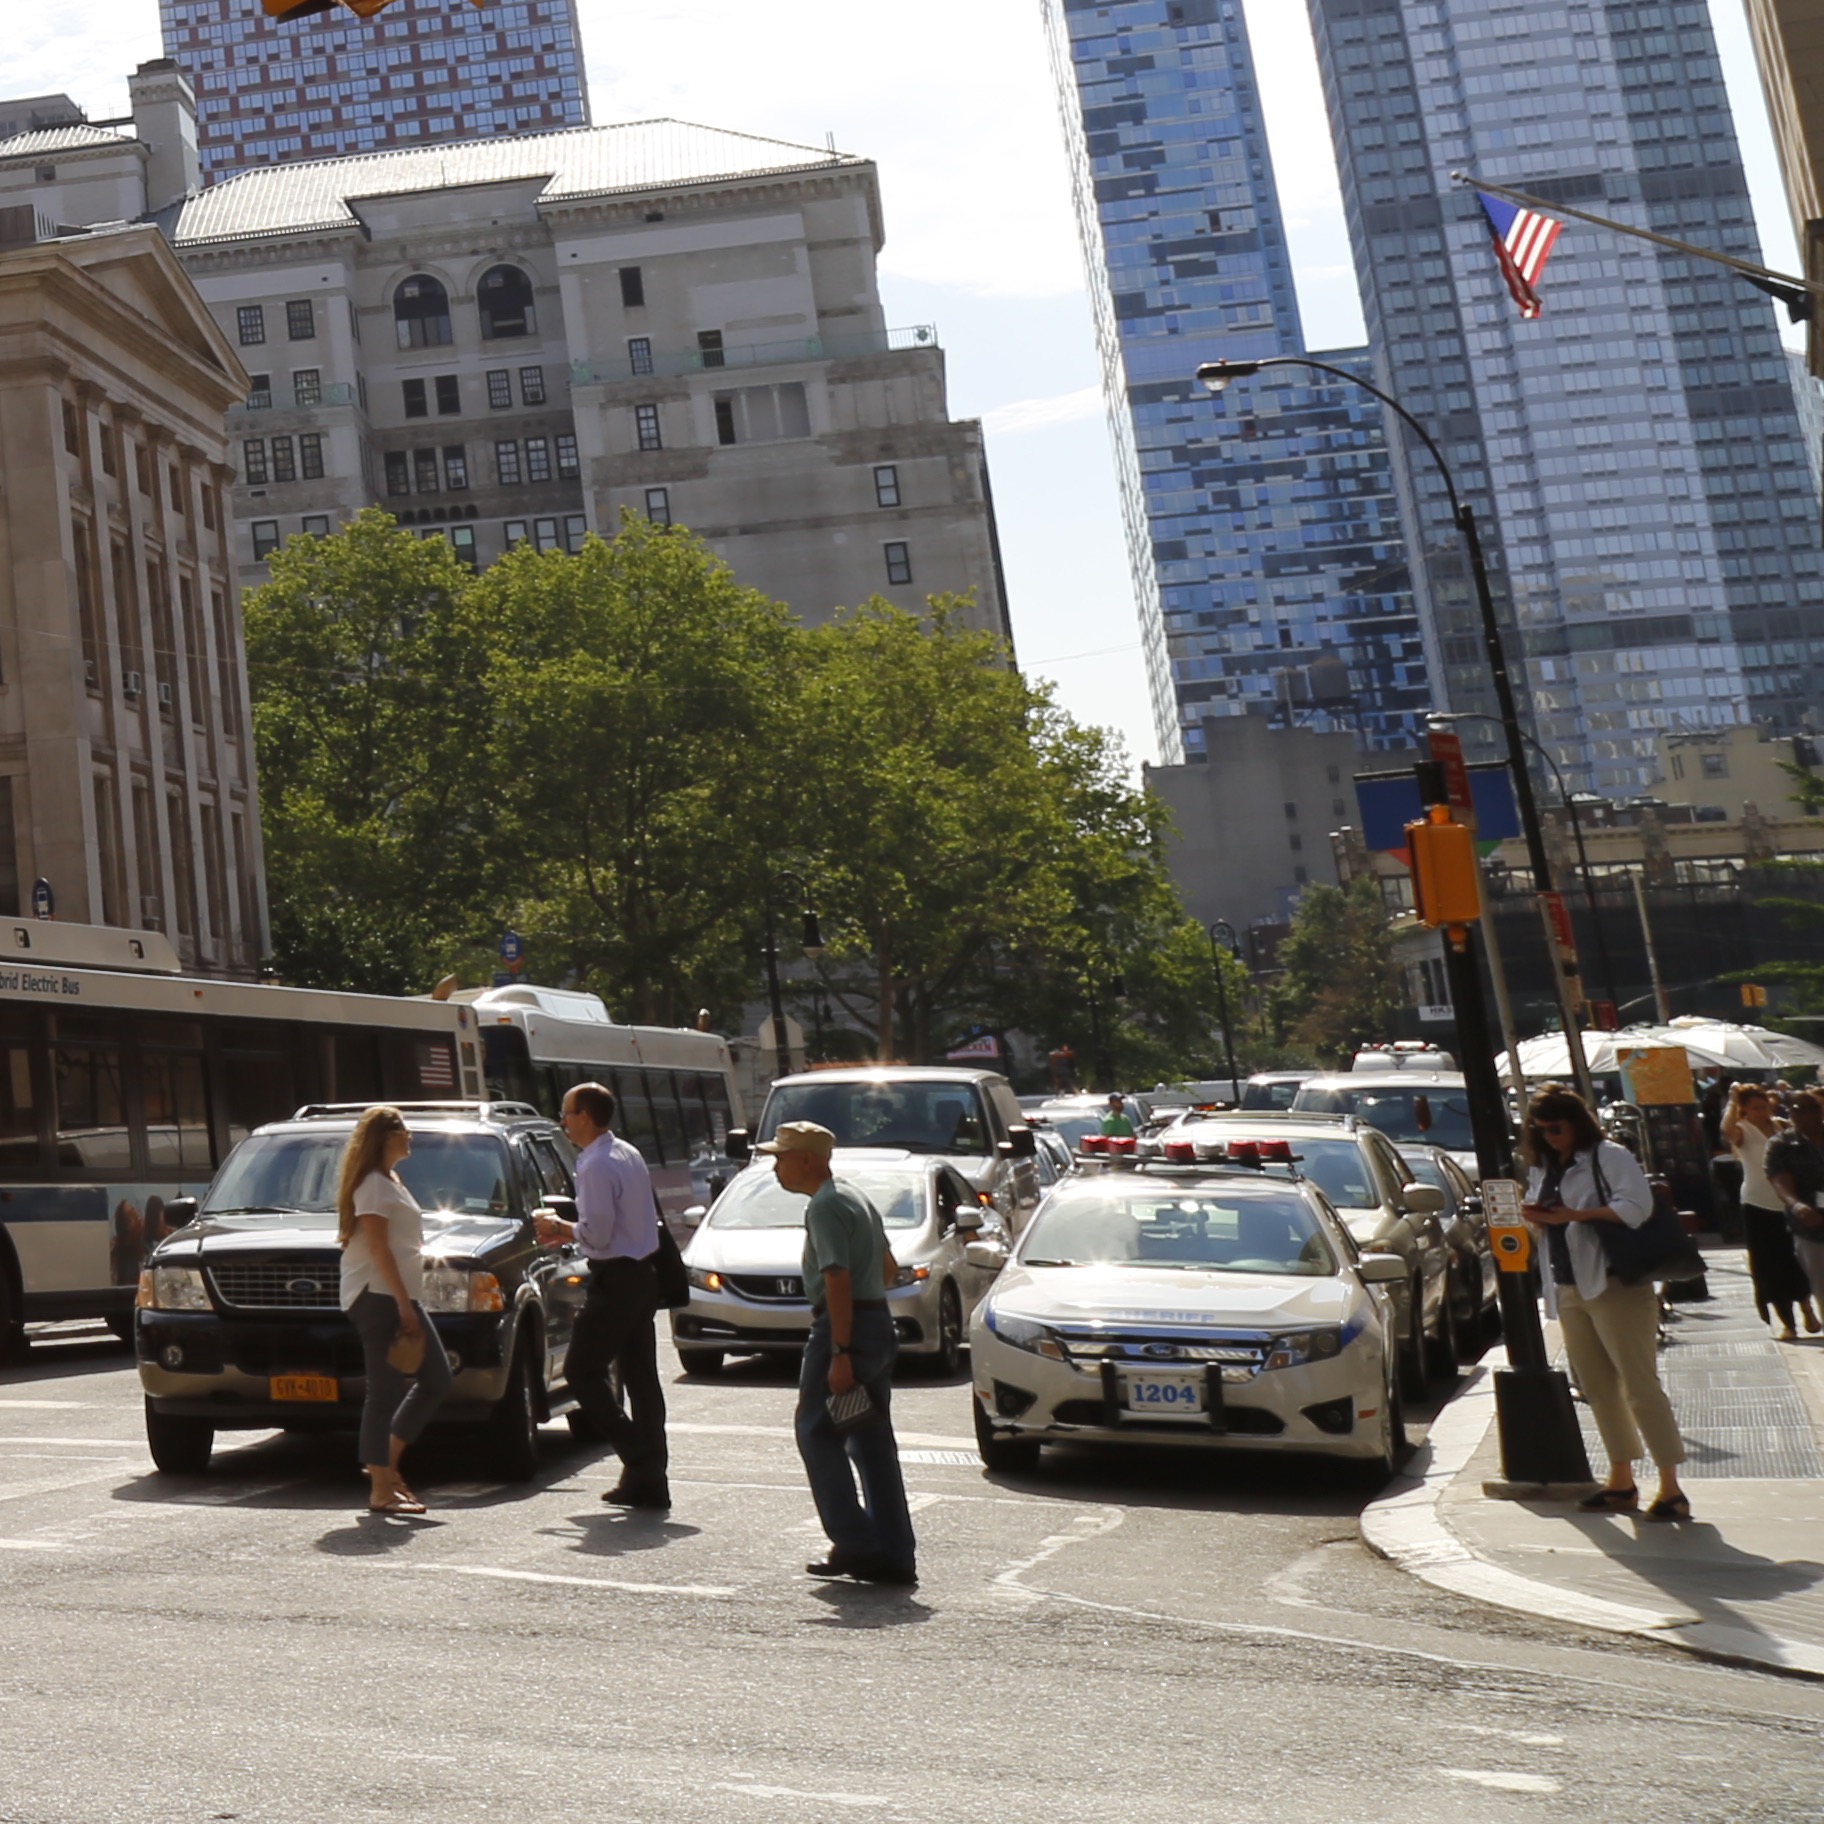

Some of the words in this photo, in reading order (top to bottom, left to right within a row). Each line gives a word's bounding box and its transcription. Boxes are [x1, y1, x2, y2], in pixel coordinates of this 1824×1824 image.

[22, 973, 59, 993] Electric
[62, 977, 80, 995] Bus
[1133, 1383, 1196, 1404] 1204
